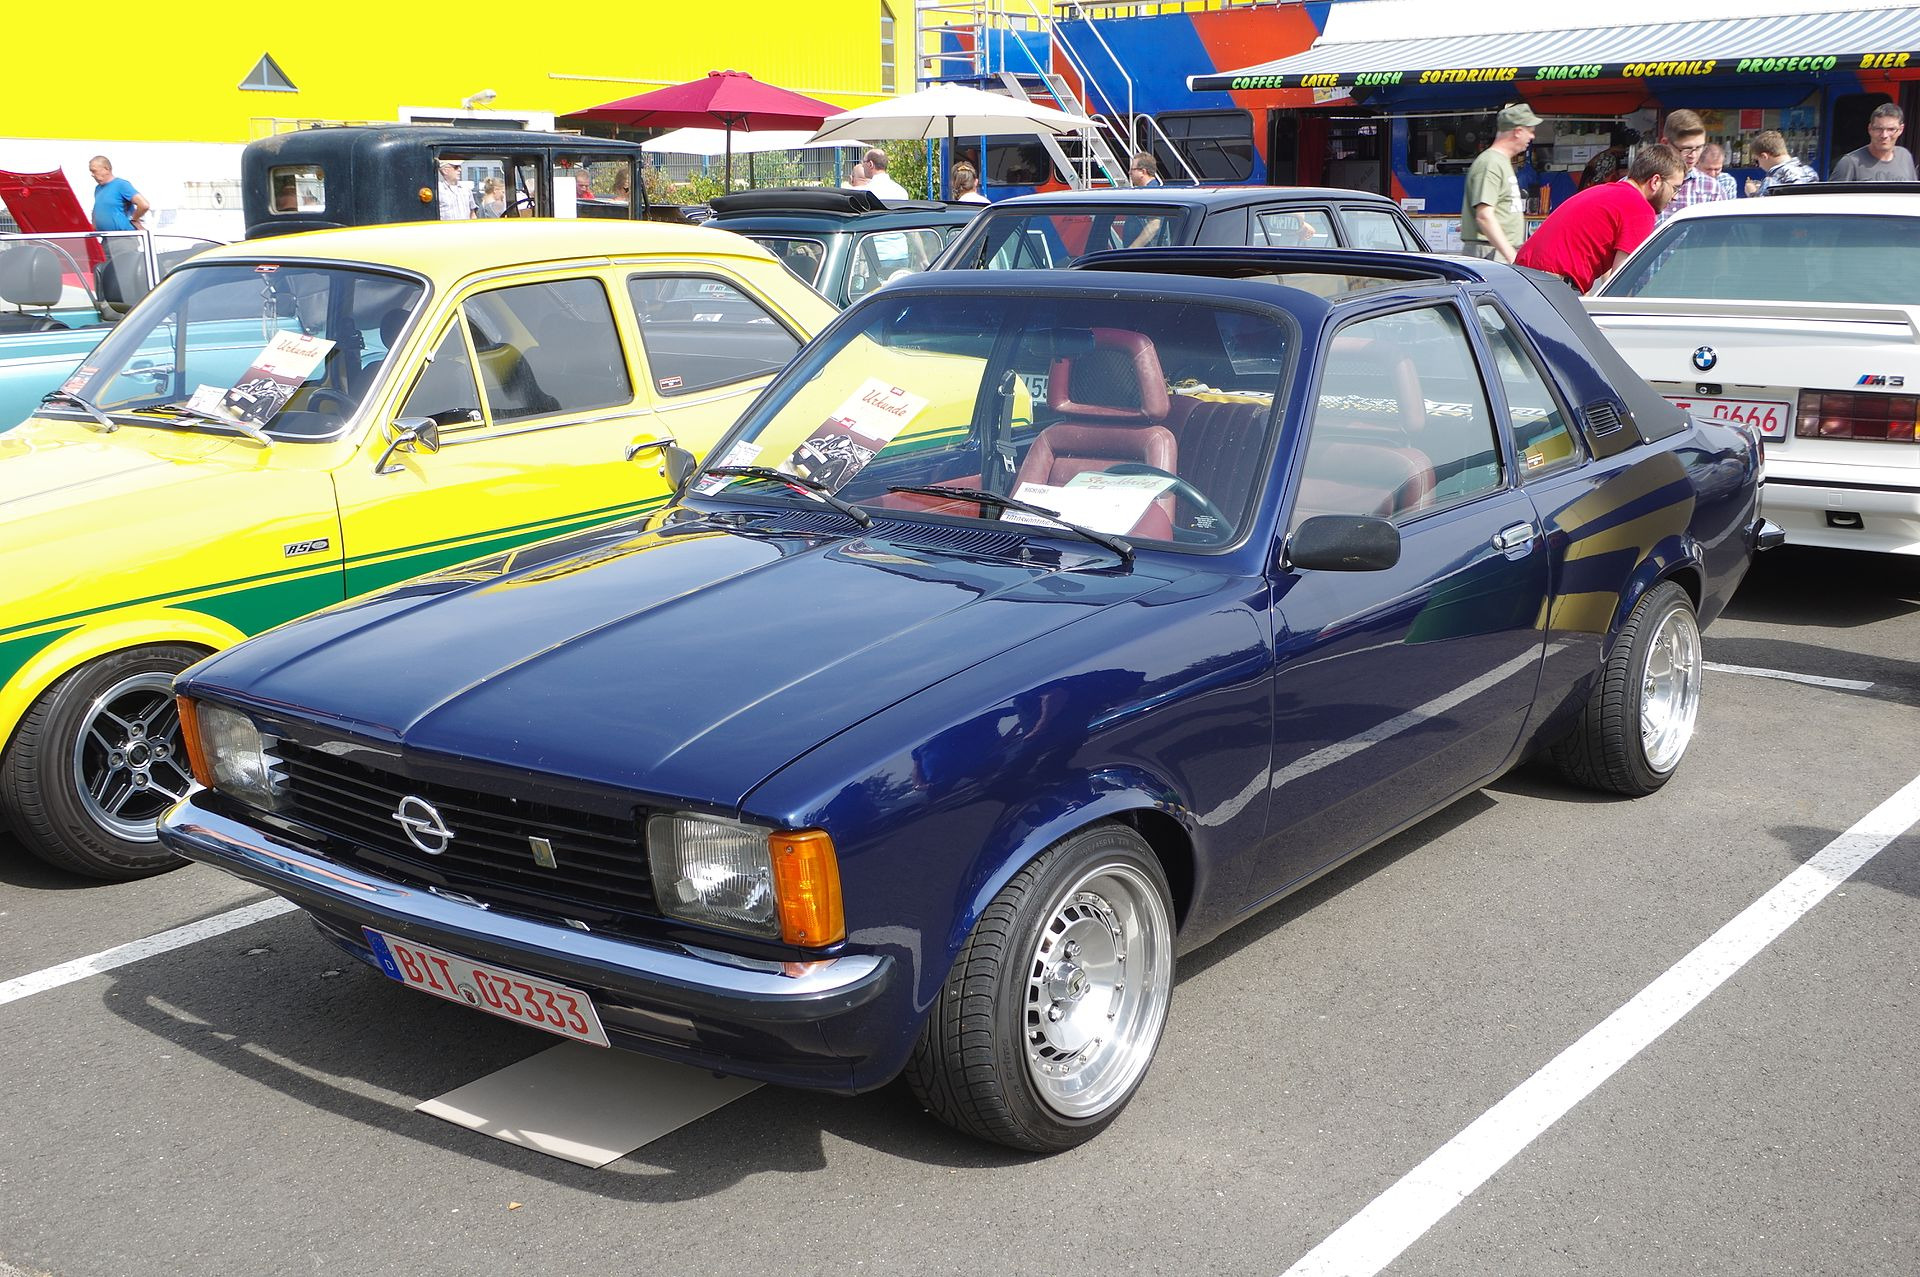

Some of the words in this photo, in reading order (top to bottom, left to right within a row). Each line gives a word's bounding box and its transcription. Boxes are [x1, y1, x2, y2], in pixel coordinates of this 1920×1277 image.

[1230, 76, 1284, 89] COFFEE
[1300, 73, 1341, 88] LATTE
[1354, 72, 1404, 86] SLUSH
[1419, 67, 1519, 83] SOFTDRINKS
[1534, 64, 1603, 81] SNACKS
[1621, 59, 1718, 78] COCKTAILS
[1735, 55, 1838, 73] PROSECCO
[1858, 52, 1911, 69] BIER
[1869, 375, 1905, 387] M3
[862, 389, 910, 417] Urkunde
[384, 958, 395, 972] D
[393, 945, 459, 996] BIT
[472, 969, 590, 1035] 03333
